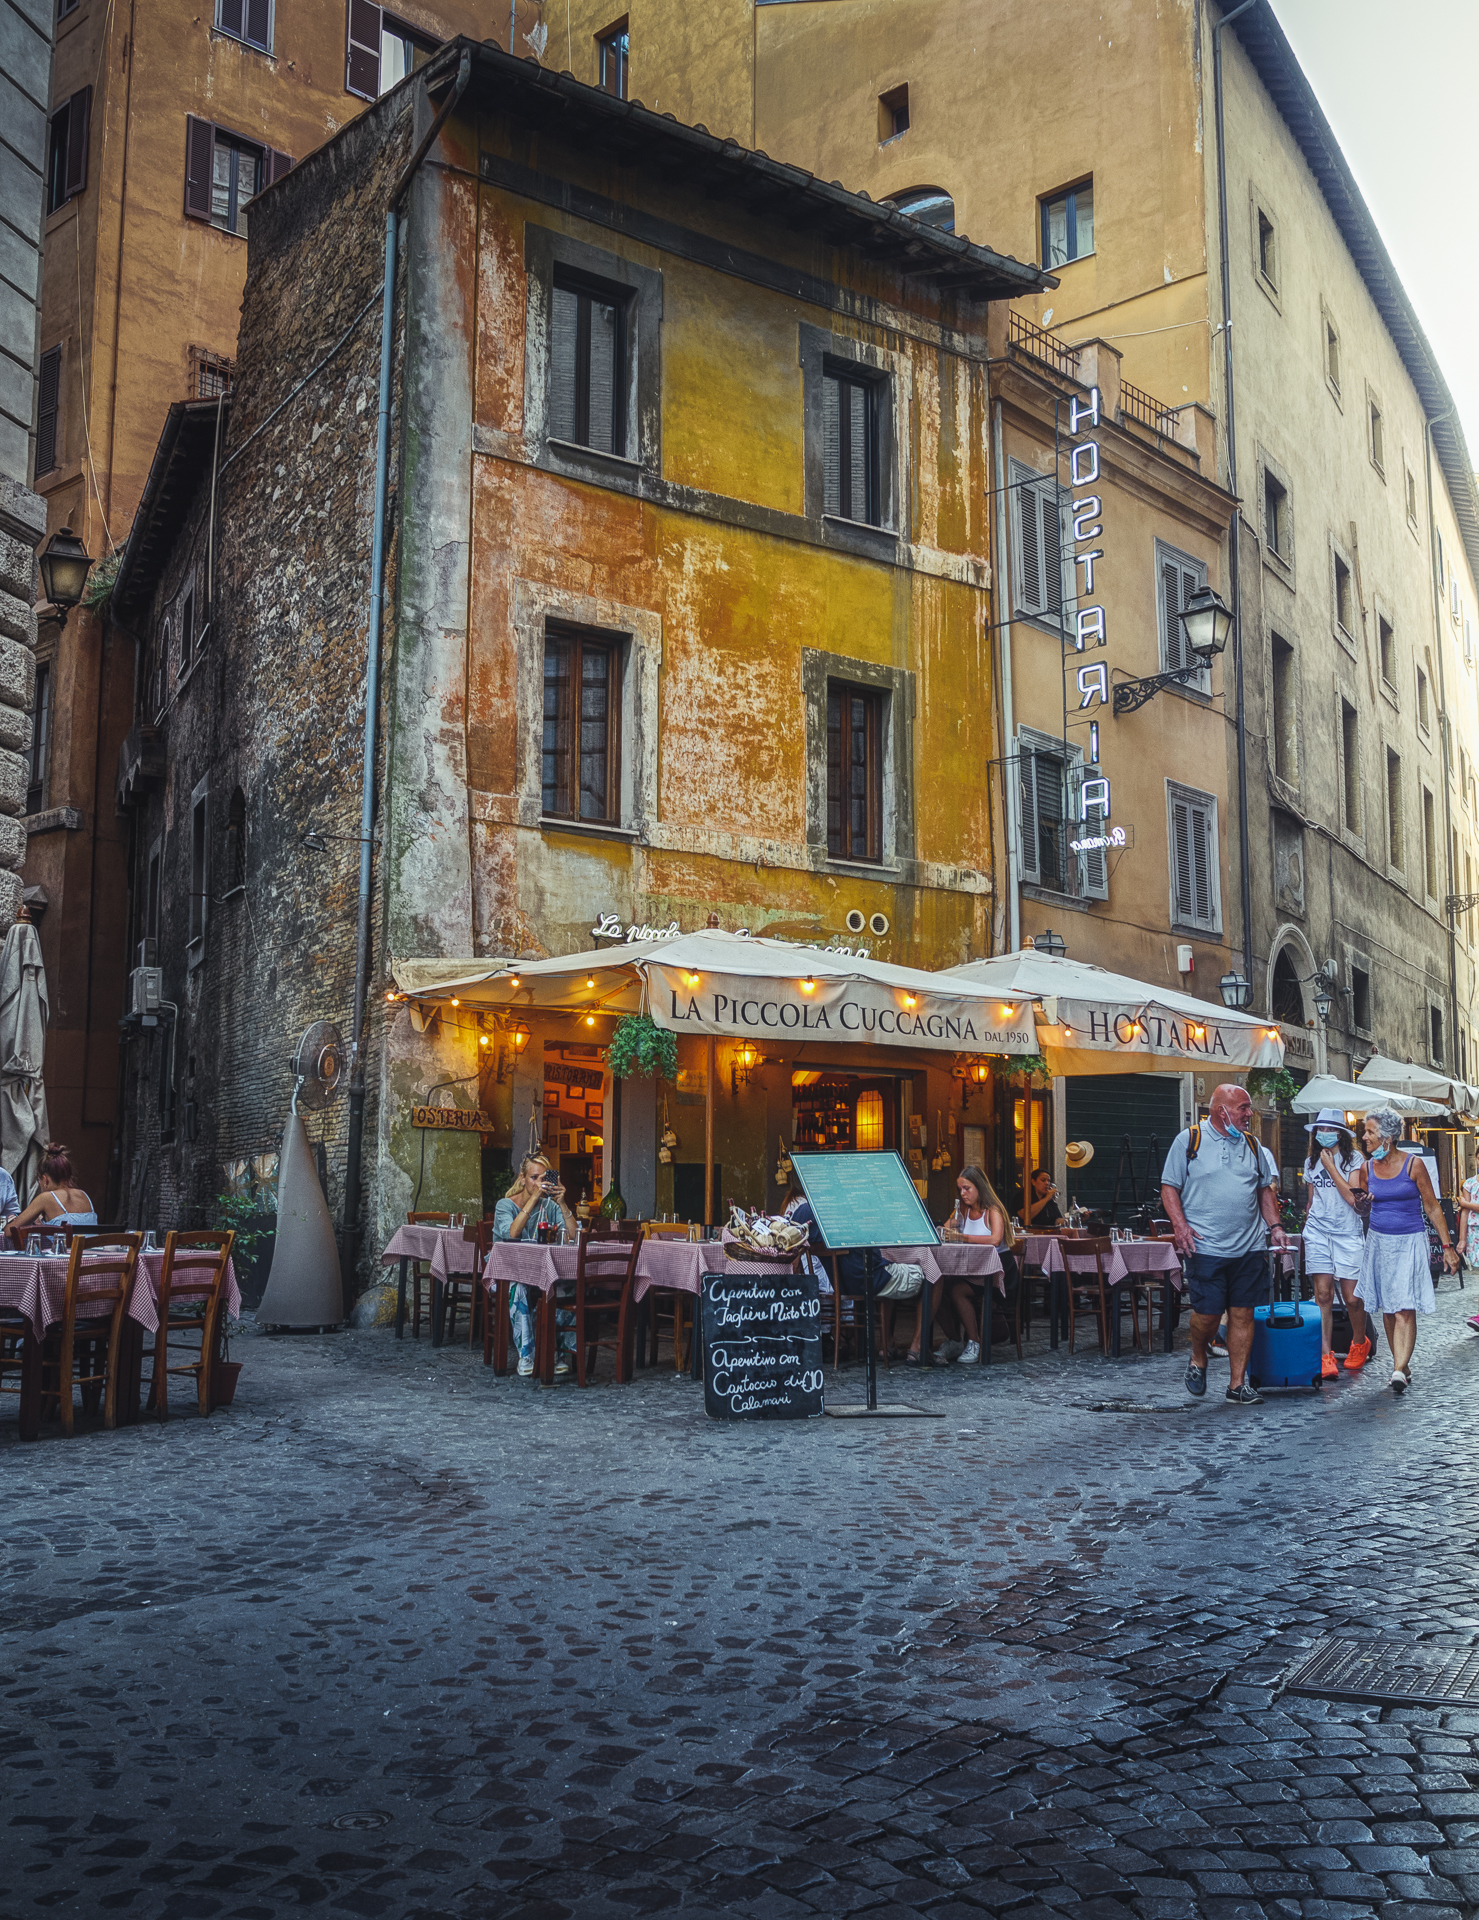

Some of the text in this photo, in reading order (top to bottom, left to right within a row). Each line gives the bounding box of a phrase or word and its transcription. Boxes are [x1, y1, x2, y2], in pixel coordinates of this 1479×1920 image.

[592, 912, 623, 938] La
[670, 990, 1029, 1044] LA PICCOLA CUCCAGNA DAL 1950
[1088, 1010, 1230, 1056] HOSTARIA
[417, 1107, 484, 1127] OSTERIA
[781, 1288, 802, 1298] con
[770, 1301, 800, 1321] Misto
[800, 1298, 820, 1317] €10
[780, 1354, 801, 1365] con
[713, 1369, 823, 1396] Cartoccio di €10
[731, 1392, 792, 1413] Calamari
